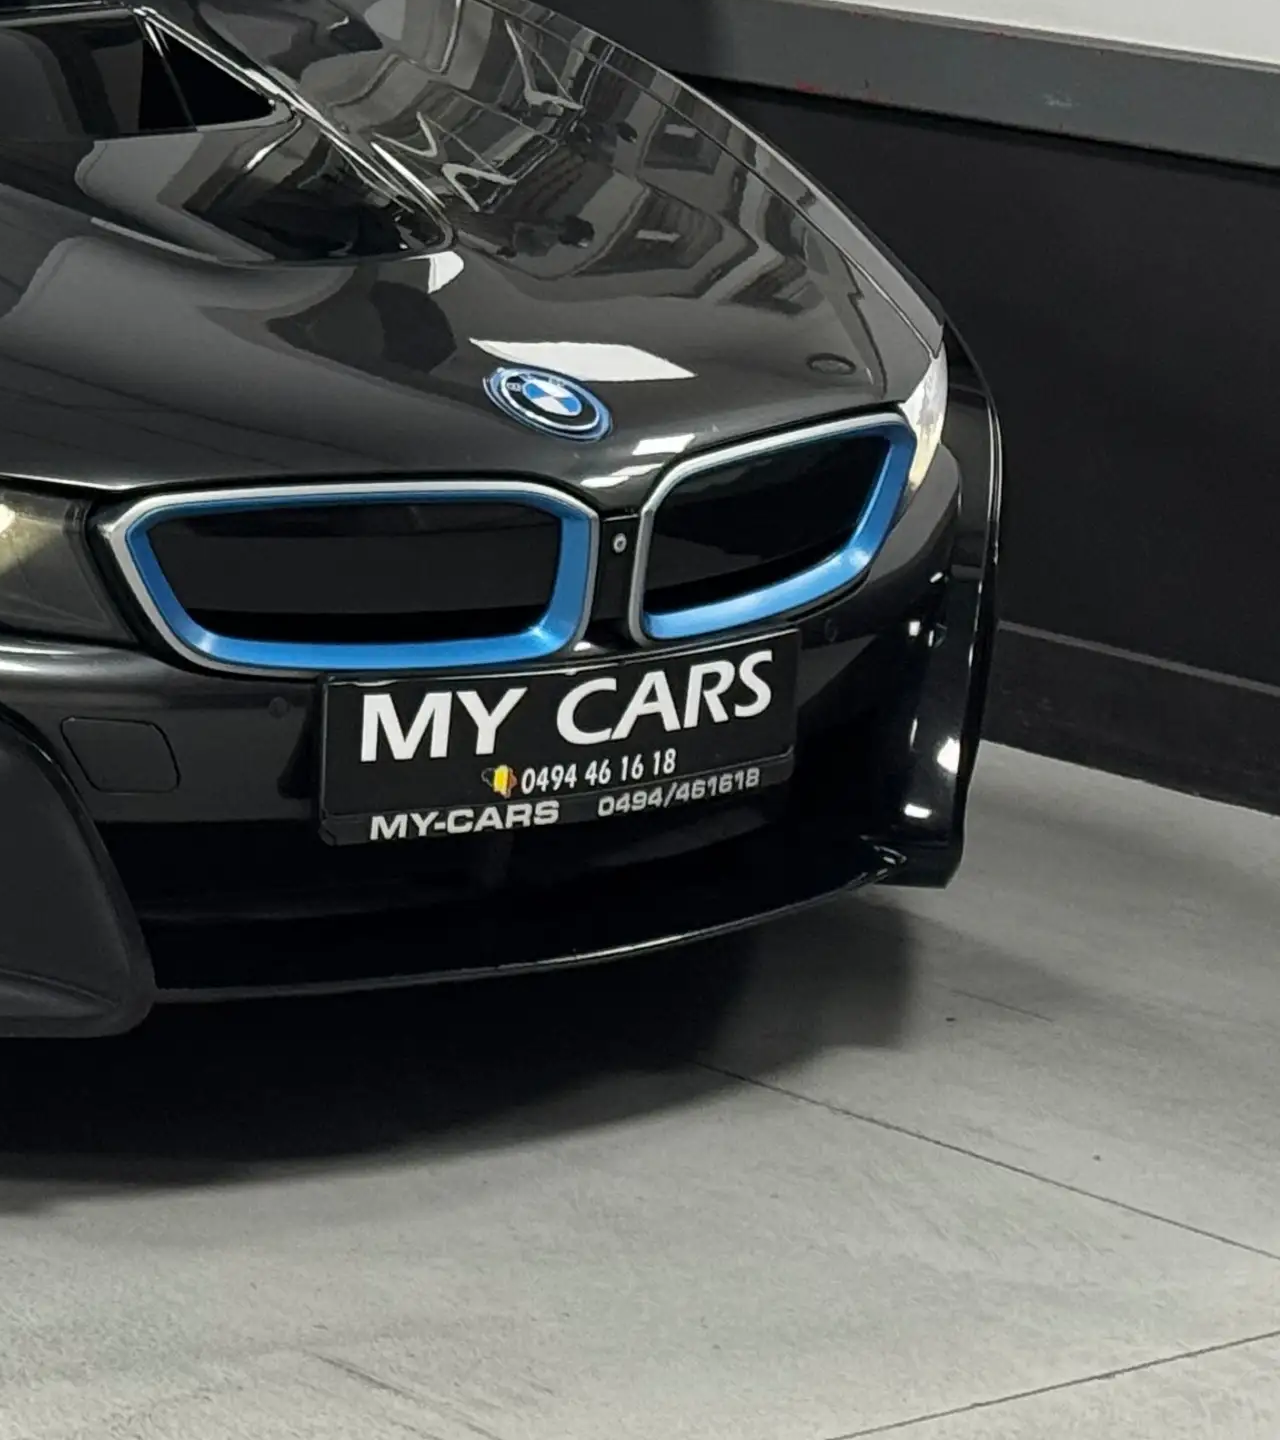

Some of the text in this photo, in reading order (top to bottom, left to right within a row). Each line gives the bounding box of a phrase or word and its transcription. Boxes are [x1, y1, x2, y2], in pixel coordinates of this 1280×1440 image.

[361, 650, 773, 762] MY CARS
[370, 767, 760, 840] MY-CARS 0494/461618
[521, 748, 677, 794] 0494 46 16 18
